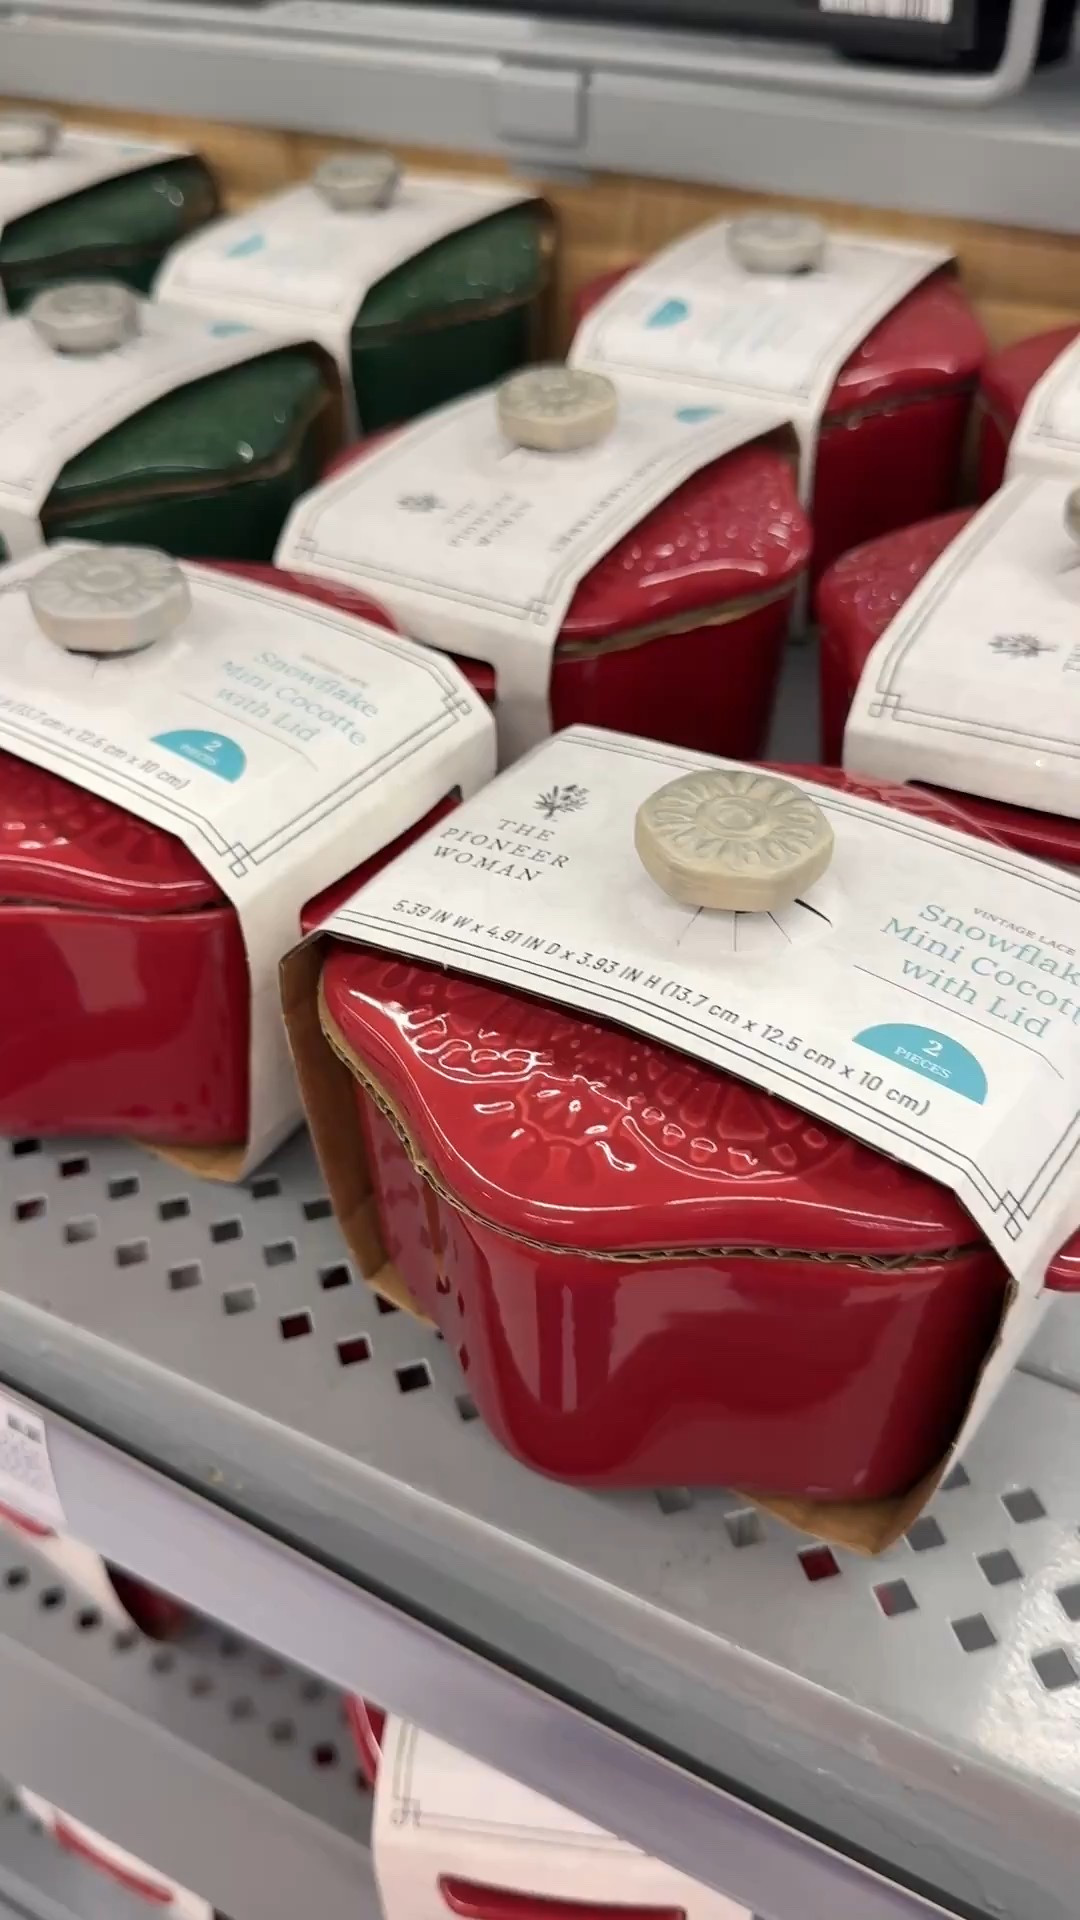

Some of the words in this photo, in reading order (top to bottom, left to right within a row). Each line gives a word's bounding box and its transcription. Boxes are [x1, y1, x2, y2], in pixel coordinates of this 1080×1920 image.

[203, 740, 222, 752] 2
[440, 827, 569, 868] PIONEER
[497, 818, 555, 842] THE
[433, 845, 543, 881] WOMAN
[879, 916, 965, 964] Mini
[918, 903, 1080, 988] Snowflak
[973, 907, 1036, 939] VINTAGE
[1038, 935, 1077, 956] LACE
[901, 958, 978, 1005] with
[392, 899, 432, 917] 5.39
[429, 909, 453, 923] IN
[452, 915, 473, 929] W
[469, 923, 484, 934] x
[486, 925, 523, 944] 4.91
[520, 935, 545, 950] IN
[544, 942, 561, 955] D
[559, 949, 575, 961] x
[576, 951, 620, 974] 3.93
[618, 965, 644, 982] IN
[643, 974, 662, 989] H
[660, 980, 710, 1007] (13.7
[708, 1004, 740, 1024] cm
[741, 1019, 758, 1032] x
[760, 1023, 803, 1052] 12.5
[803, 1048, 837, 1069] cm
[838, 1064, 855, 1079] x
[858, 1070, 884, 1091] 10
[885, 1088, 931, 1116] cm)
[985, 995, 1052, 1038] Lid
[893, 1046, 953, 1079] PIECES
[921, 1039, 944, 1057] 2
